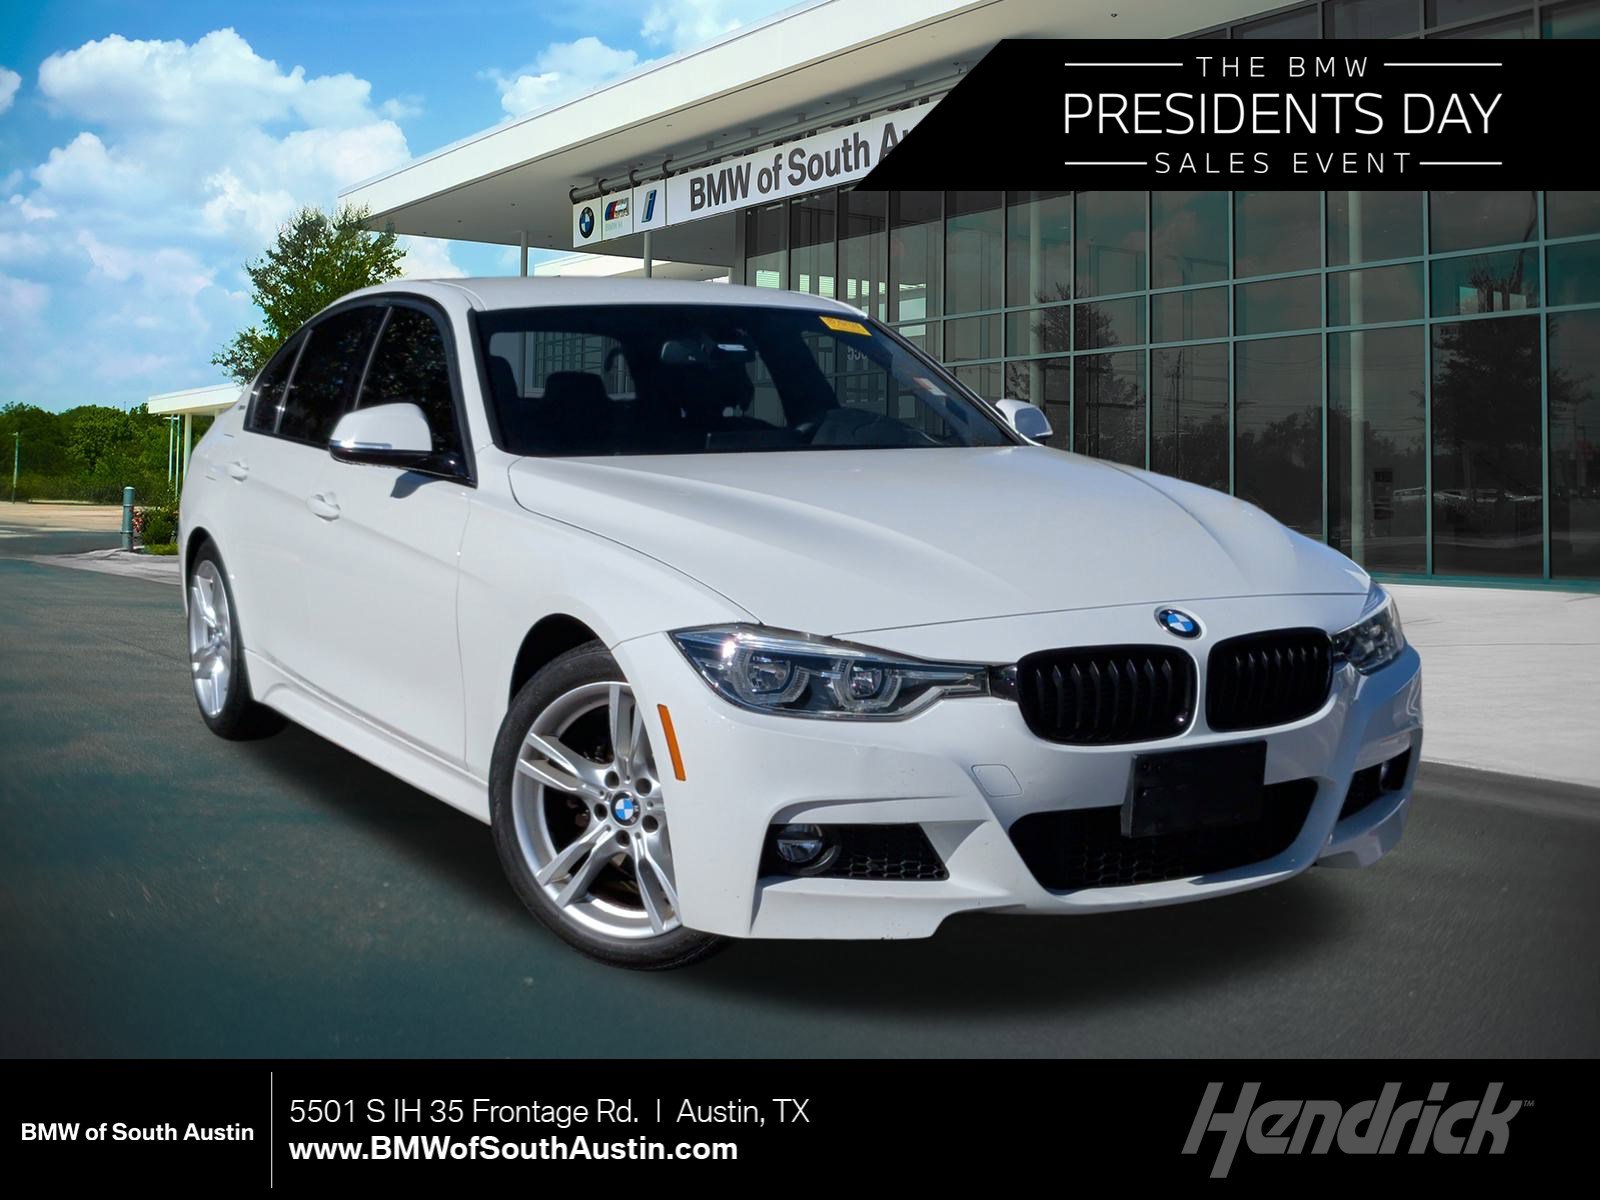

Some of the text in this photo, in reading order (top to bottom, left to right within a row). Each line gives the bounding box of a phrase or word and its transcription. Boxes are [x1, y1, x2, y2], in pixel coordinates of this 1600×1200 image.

[690, 121, 909, 211] BMW of South A
